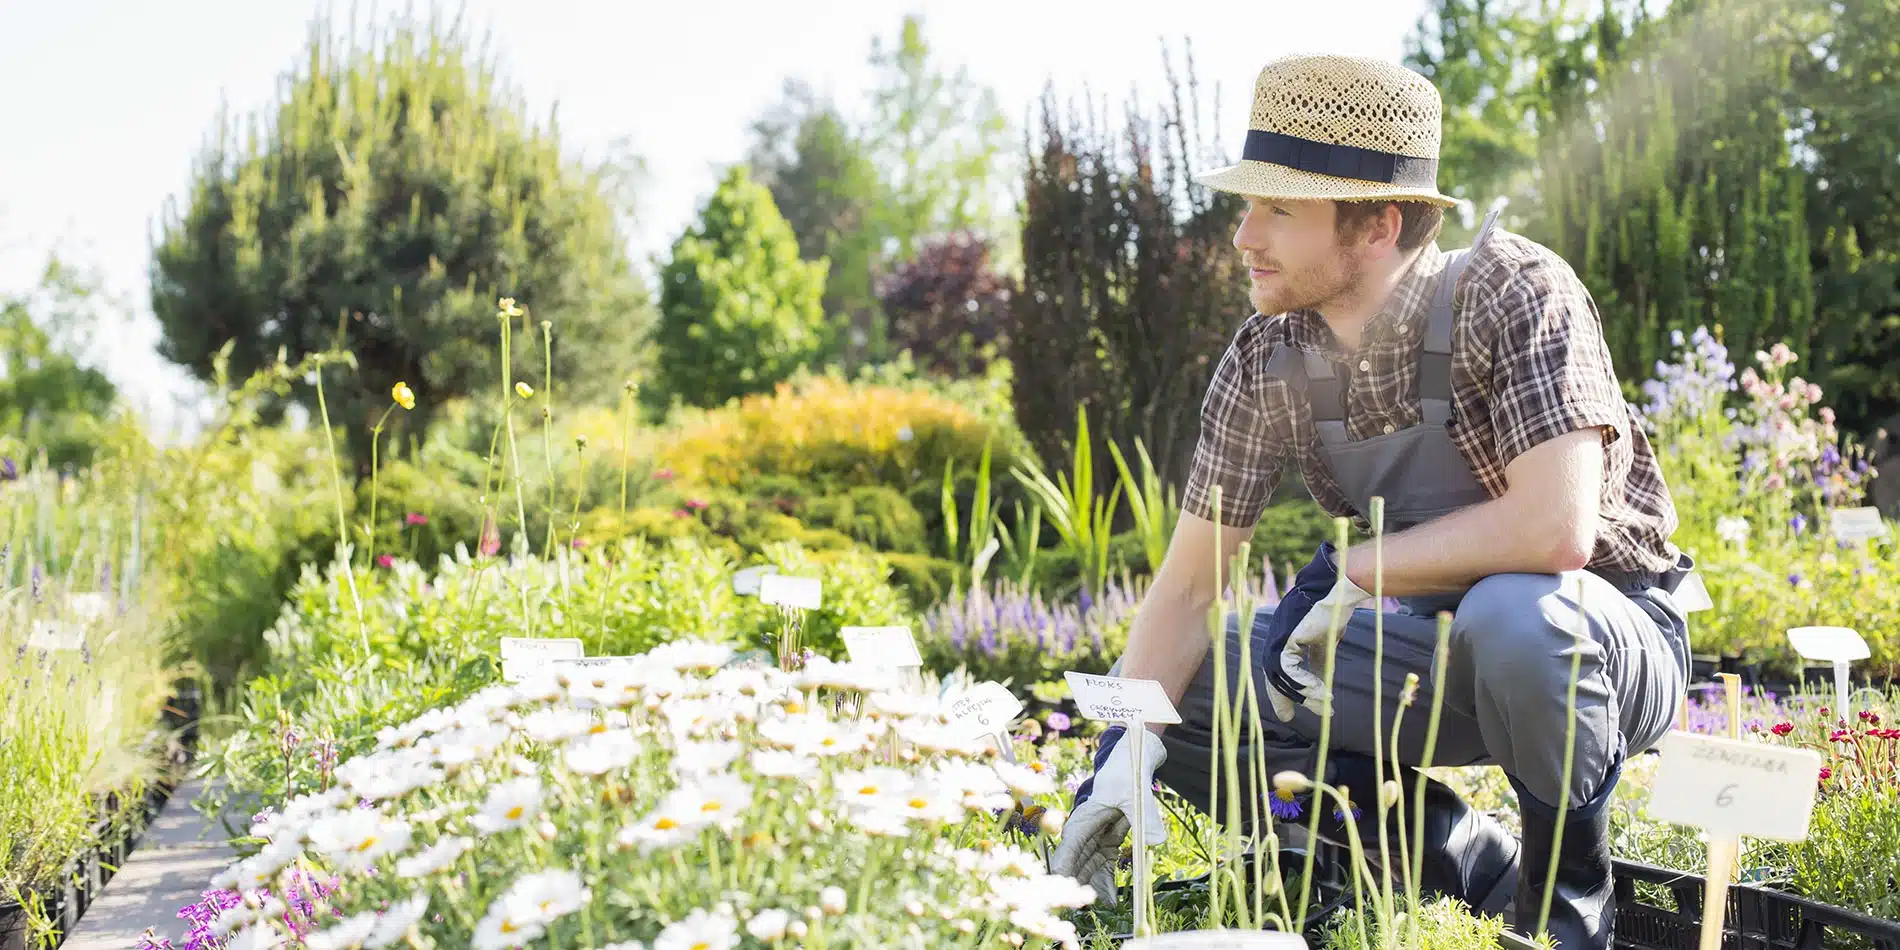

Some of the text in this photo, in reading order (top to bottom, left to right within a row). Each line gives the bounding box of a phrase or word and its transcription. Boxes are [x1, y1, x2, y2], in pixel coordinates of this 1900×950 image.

[1085, 678, 1122, 690] FLOKS
[1110, 696, 1122, 706] 6
[978, 714, 990, 726] 6
[1715, 783, 1739, 808] 6
